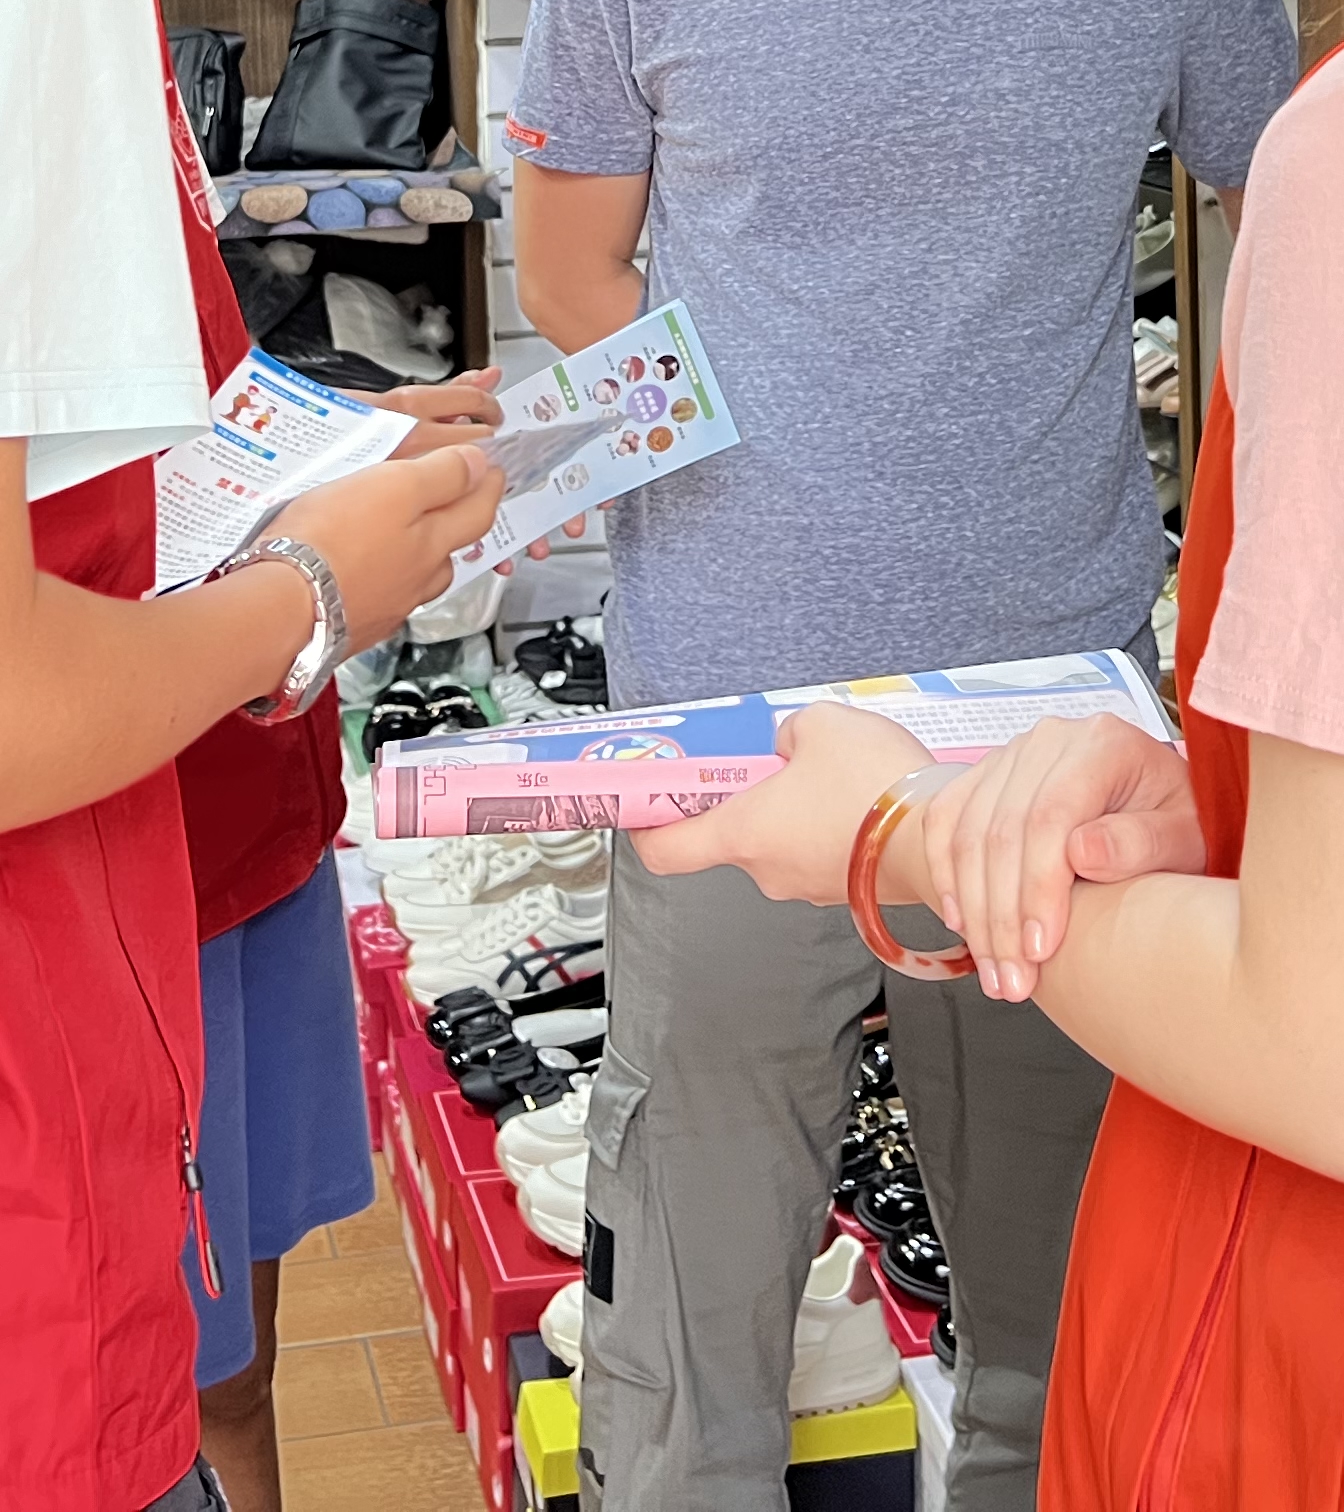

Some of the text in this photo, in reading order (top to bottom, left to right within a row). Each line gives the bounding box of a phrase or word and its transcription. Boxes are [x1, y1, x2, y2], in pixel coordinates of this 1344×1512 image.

[516, 772, 549, 787] 可乐
[698, 767, 748, 784] 跳跳糖
